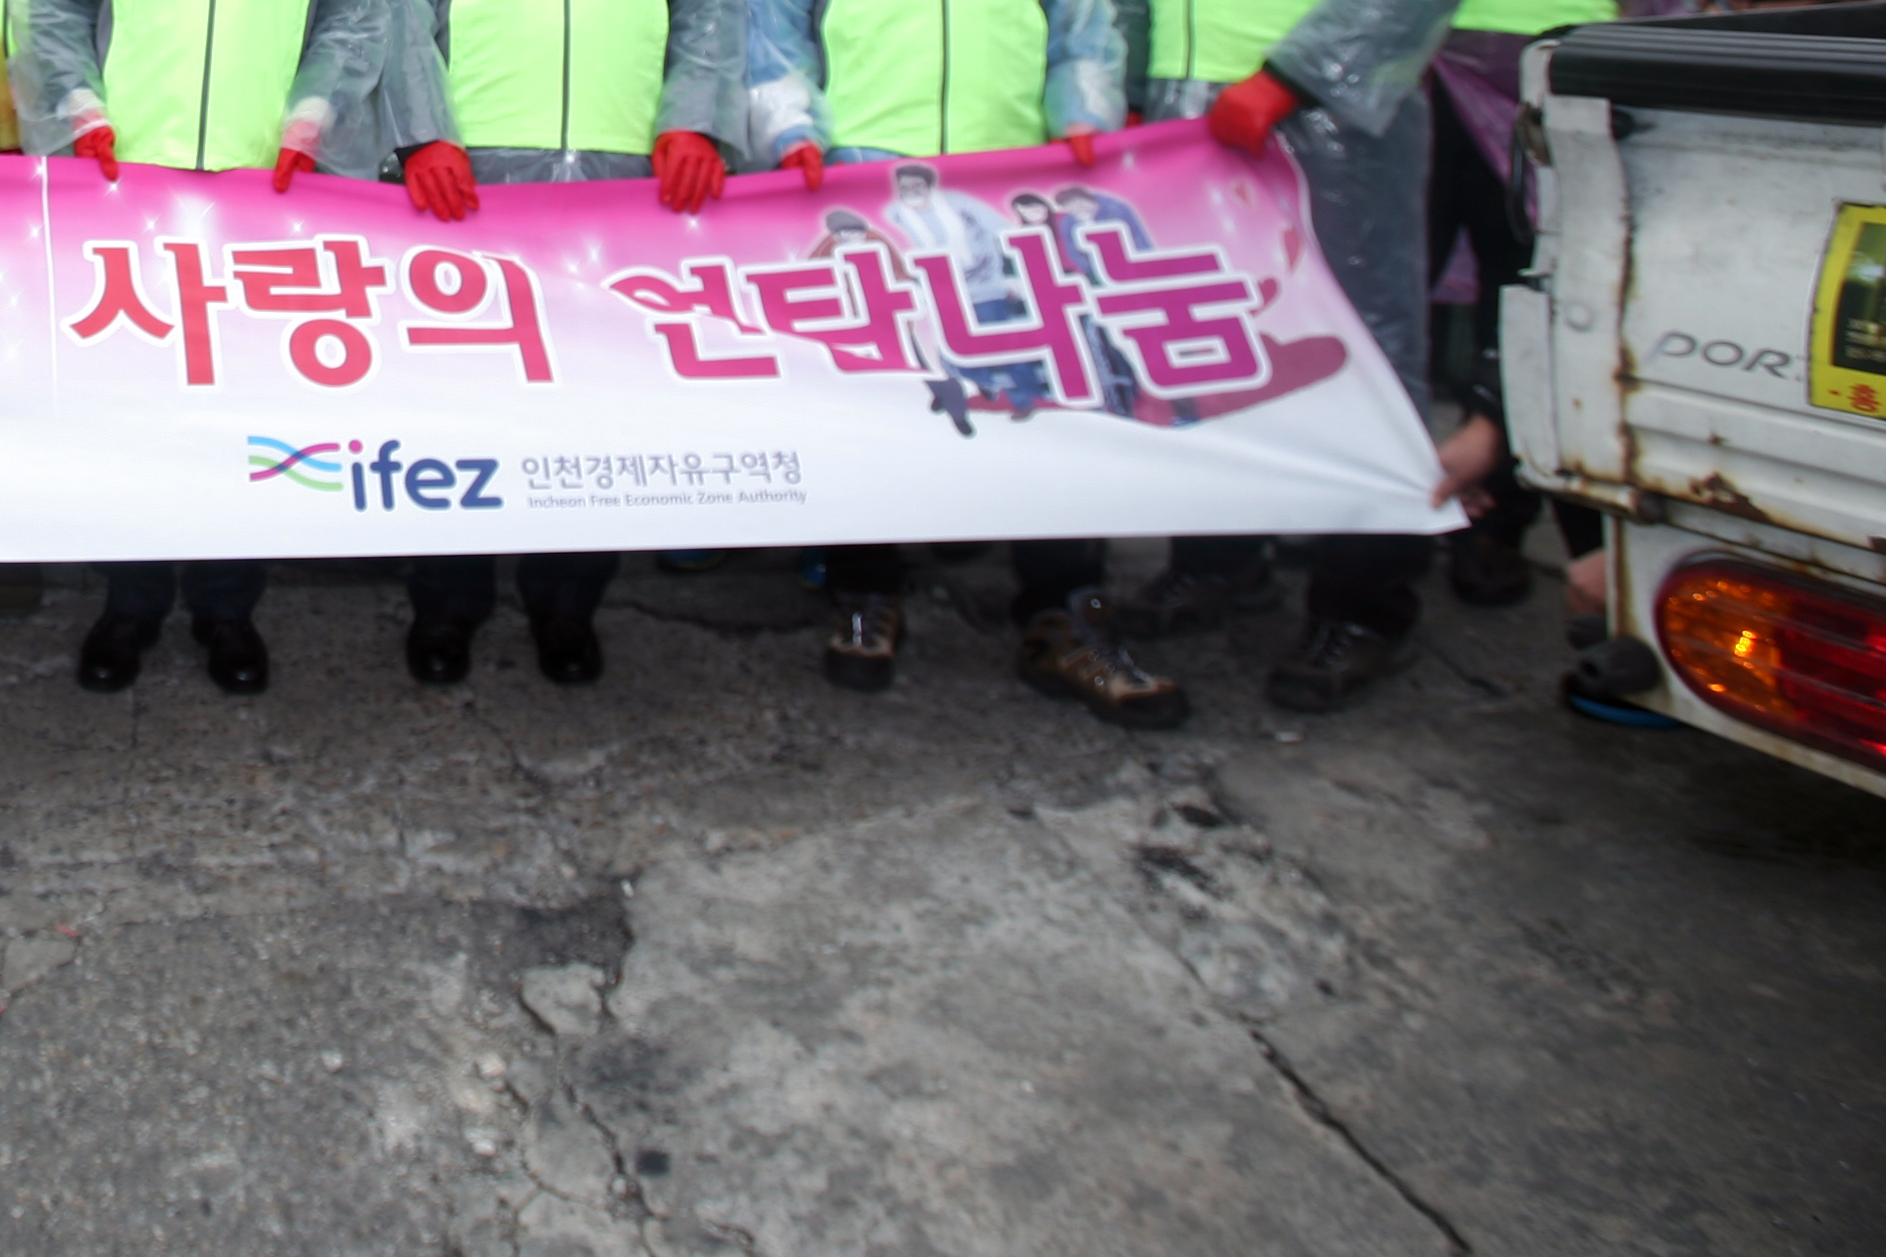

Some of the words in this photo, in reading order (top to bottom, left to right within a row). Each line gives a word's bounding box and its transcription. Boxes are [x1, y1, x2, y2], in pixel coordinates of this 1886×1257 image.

[69, 240, 555, 387] 사랑의
[348, 439, 504, 511] ifez
[520, 451, 803, 490] 인천경제자유구역청
[528, 495, 587, 509] Incheon
[590, 495, 622, 508] Free
[625, 493, 693, 507] Economic
[697, 492, 733, 505] Zone
[739, 489, 808, 506] Authority
